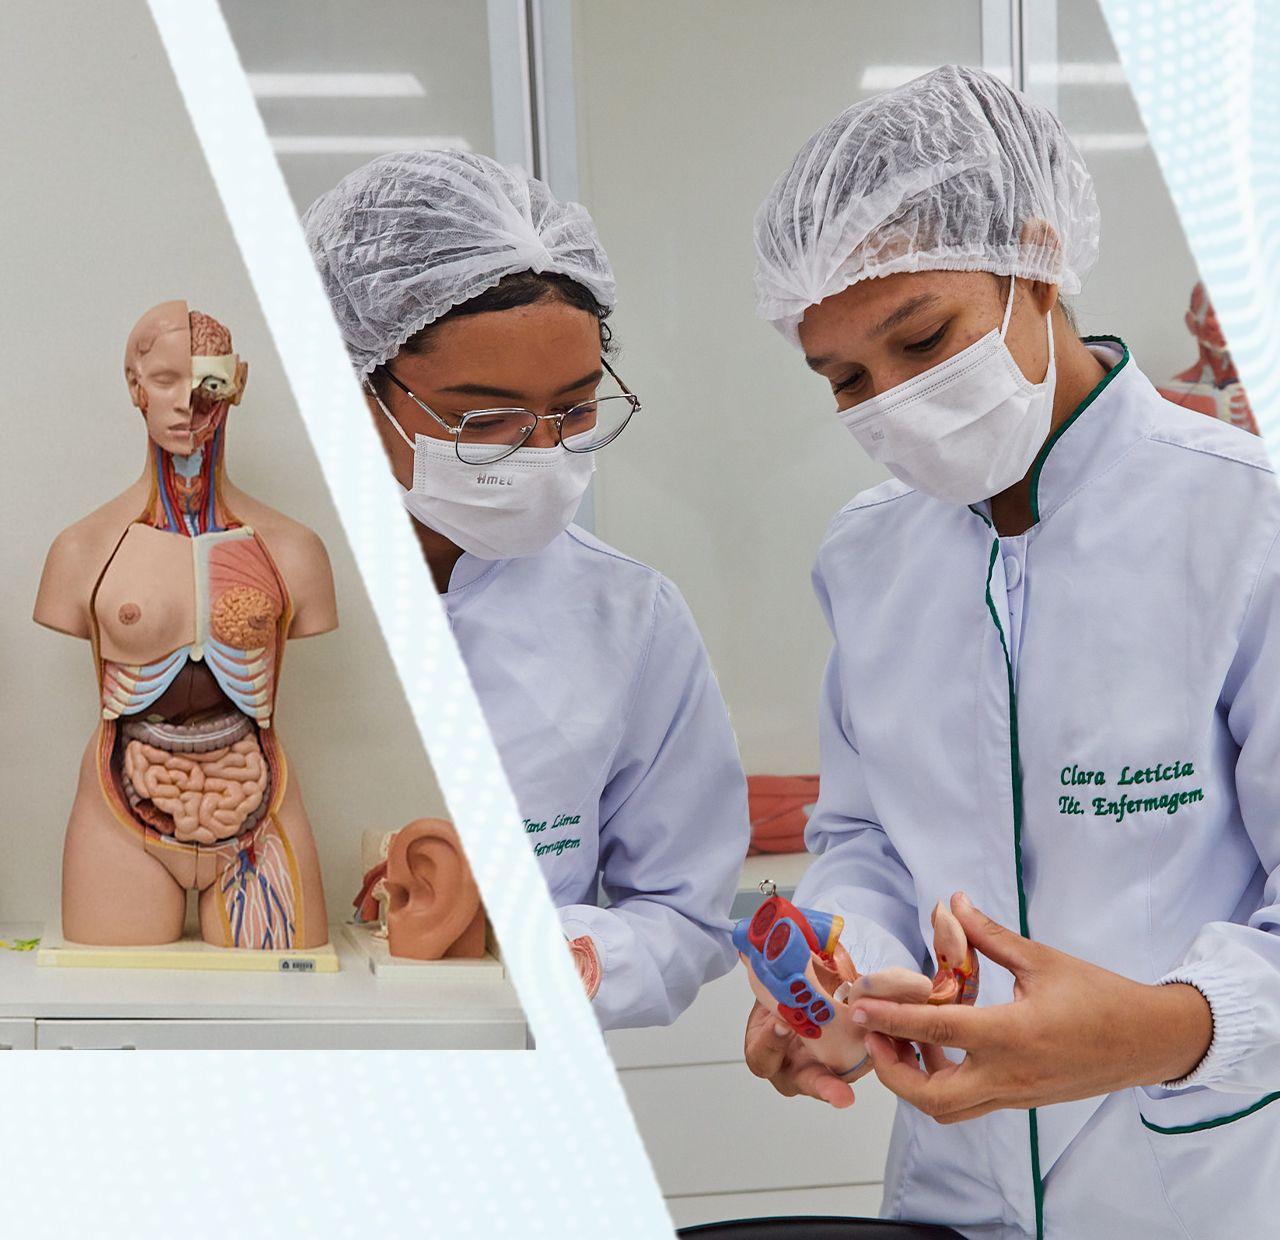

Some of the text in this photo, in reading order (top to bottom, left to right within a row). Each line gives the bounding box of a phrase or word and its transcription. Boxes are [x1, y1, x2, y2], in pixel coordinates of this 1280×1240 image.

[1059, 764, 1106, 786] Clara
[1092, 788, 1205, 823] Enfermagem
[551, 814, 581, 830] Lima
